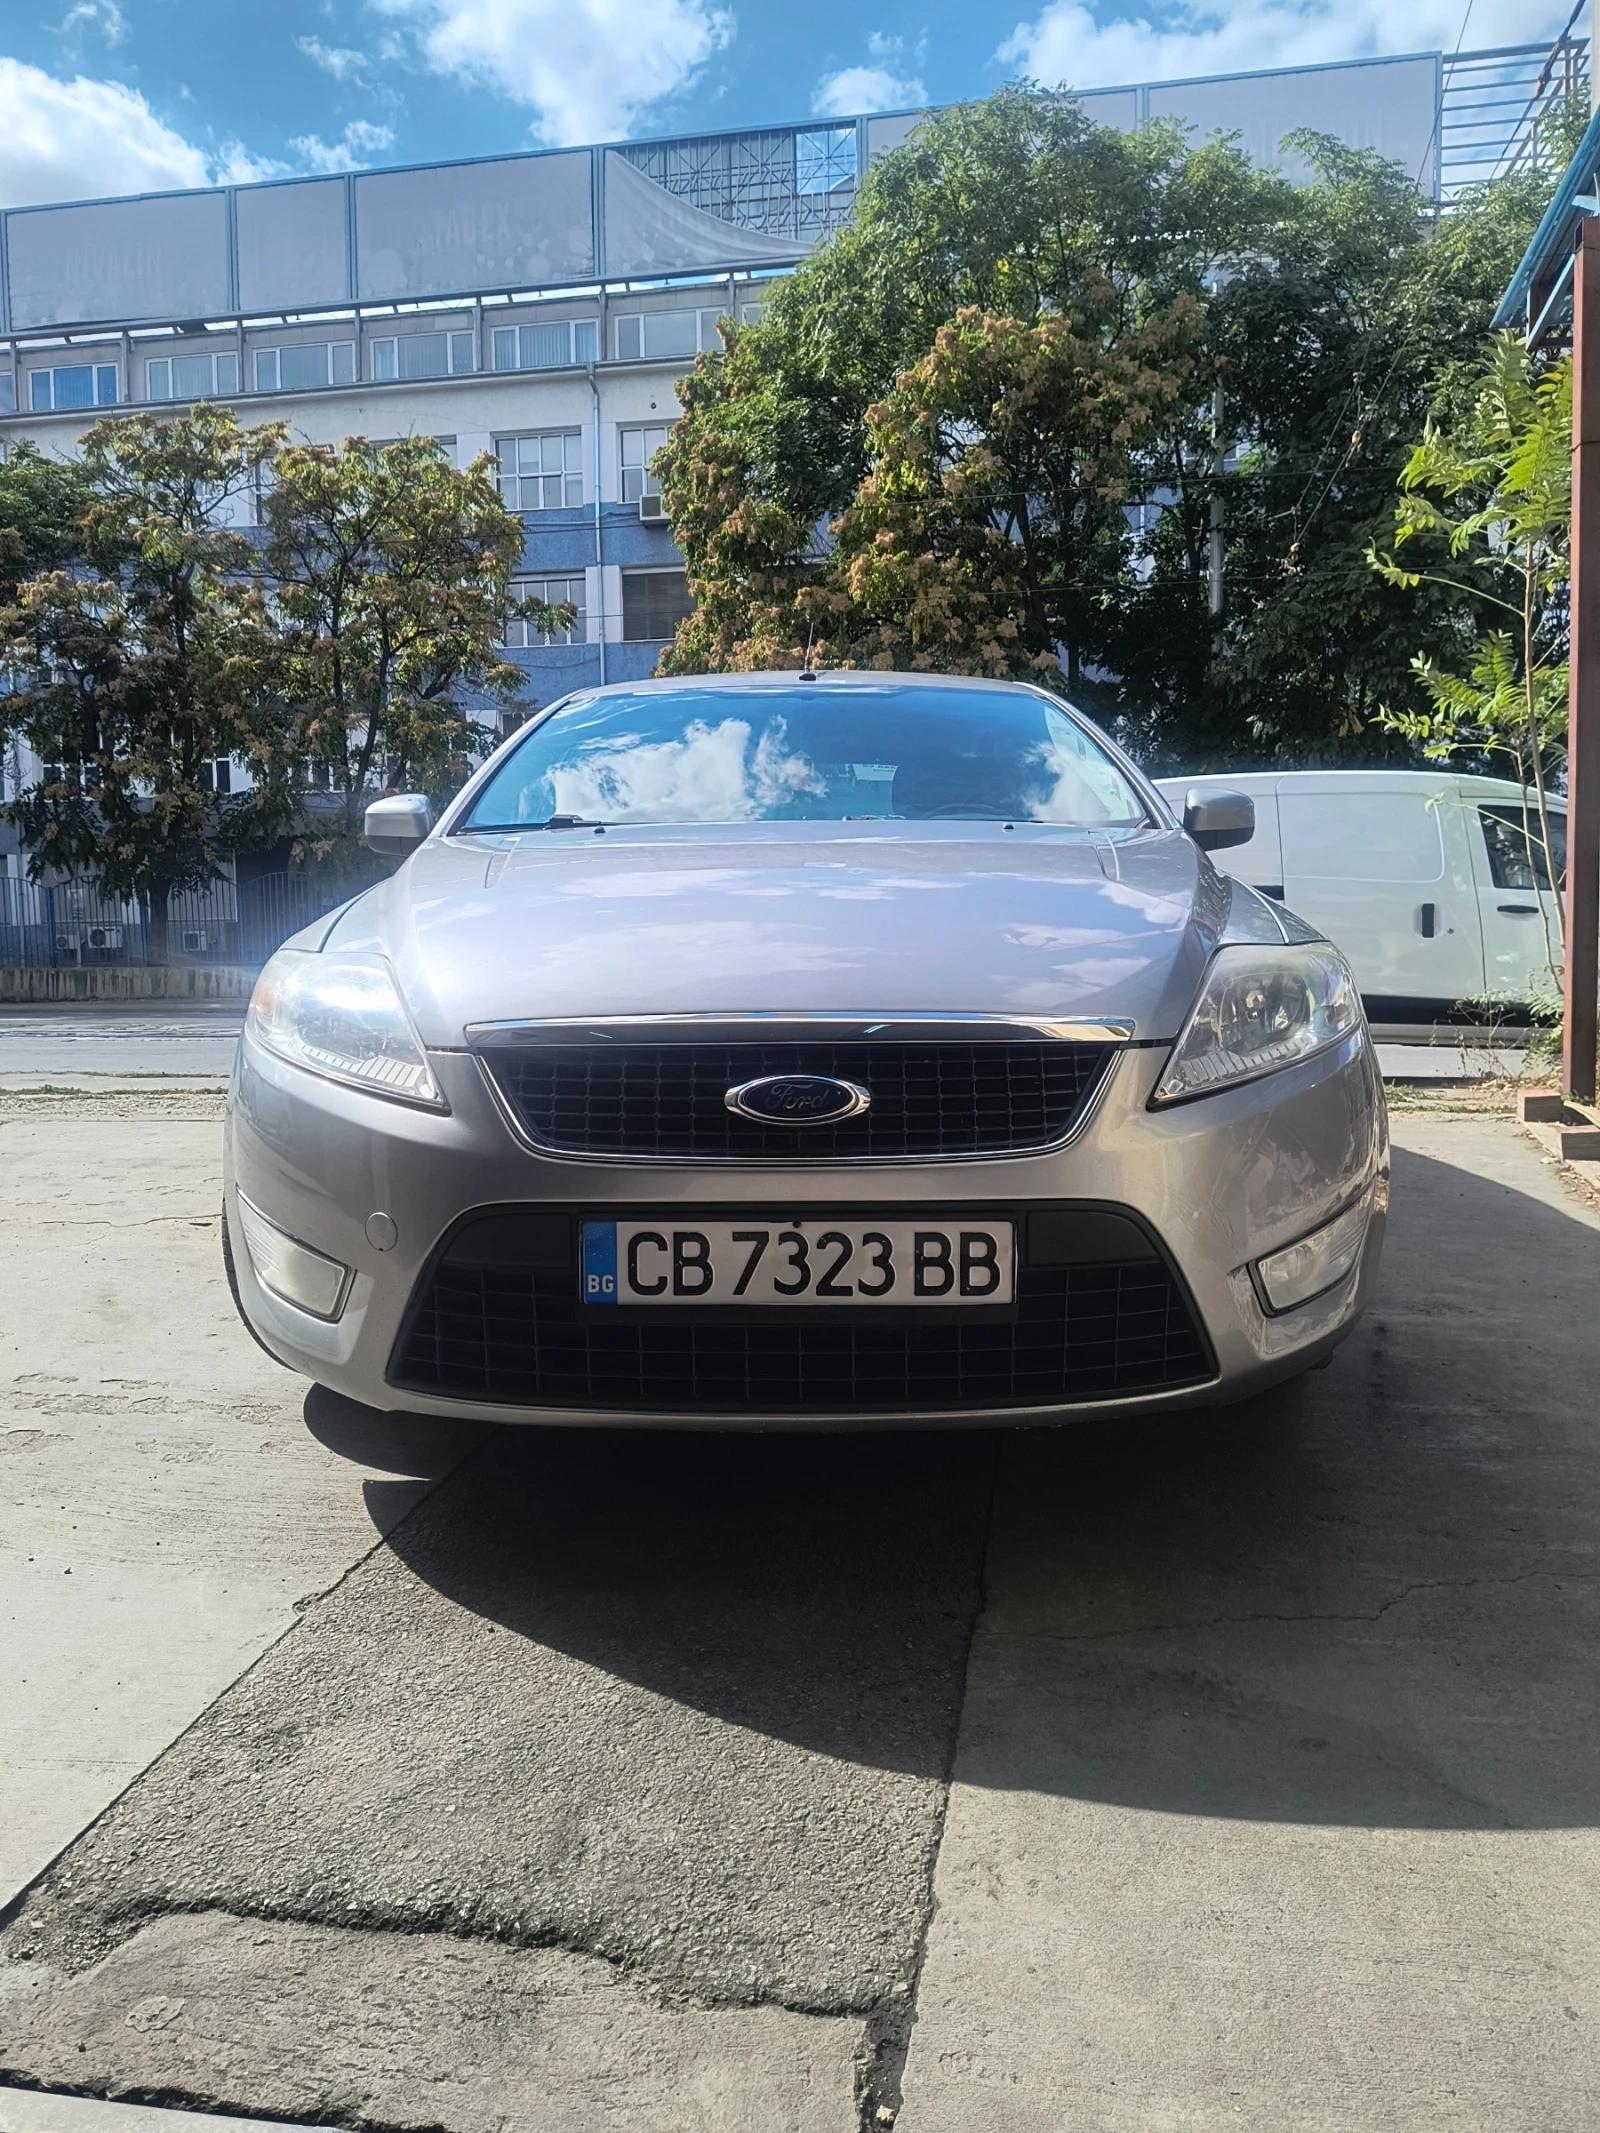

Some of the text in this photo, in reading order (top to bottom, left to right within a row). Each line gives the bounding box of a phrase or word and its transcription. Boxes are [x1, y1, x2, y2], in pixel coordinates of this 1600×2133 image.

[765, 1083, 831, 1110] Ford
[627, 1230, 1001, 1298] CB 7323 BB
[587, 1273, 615, 1294] BG
